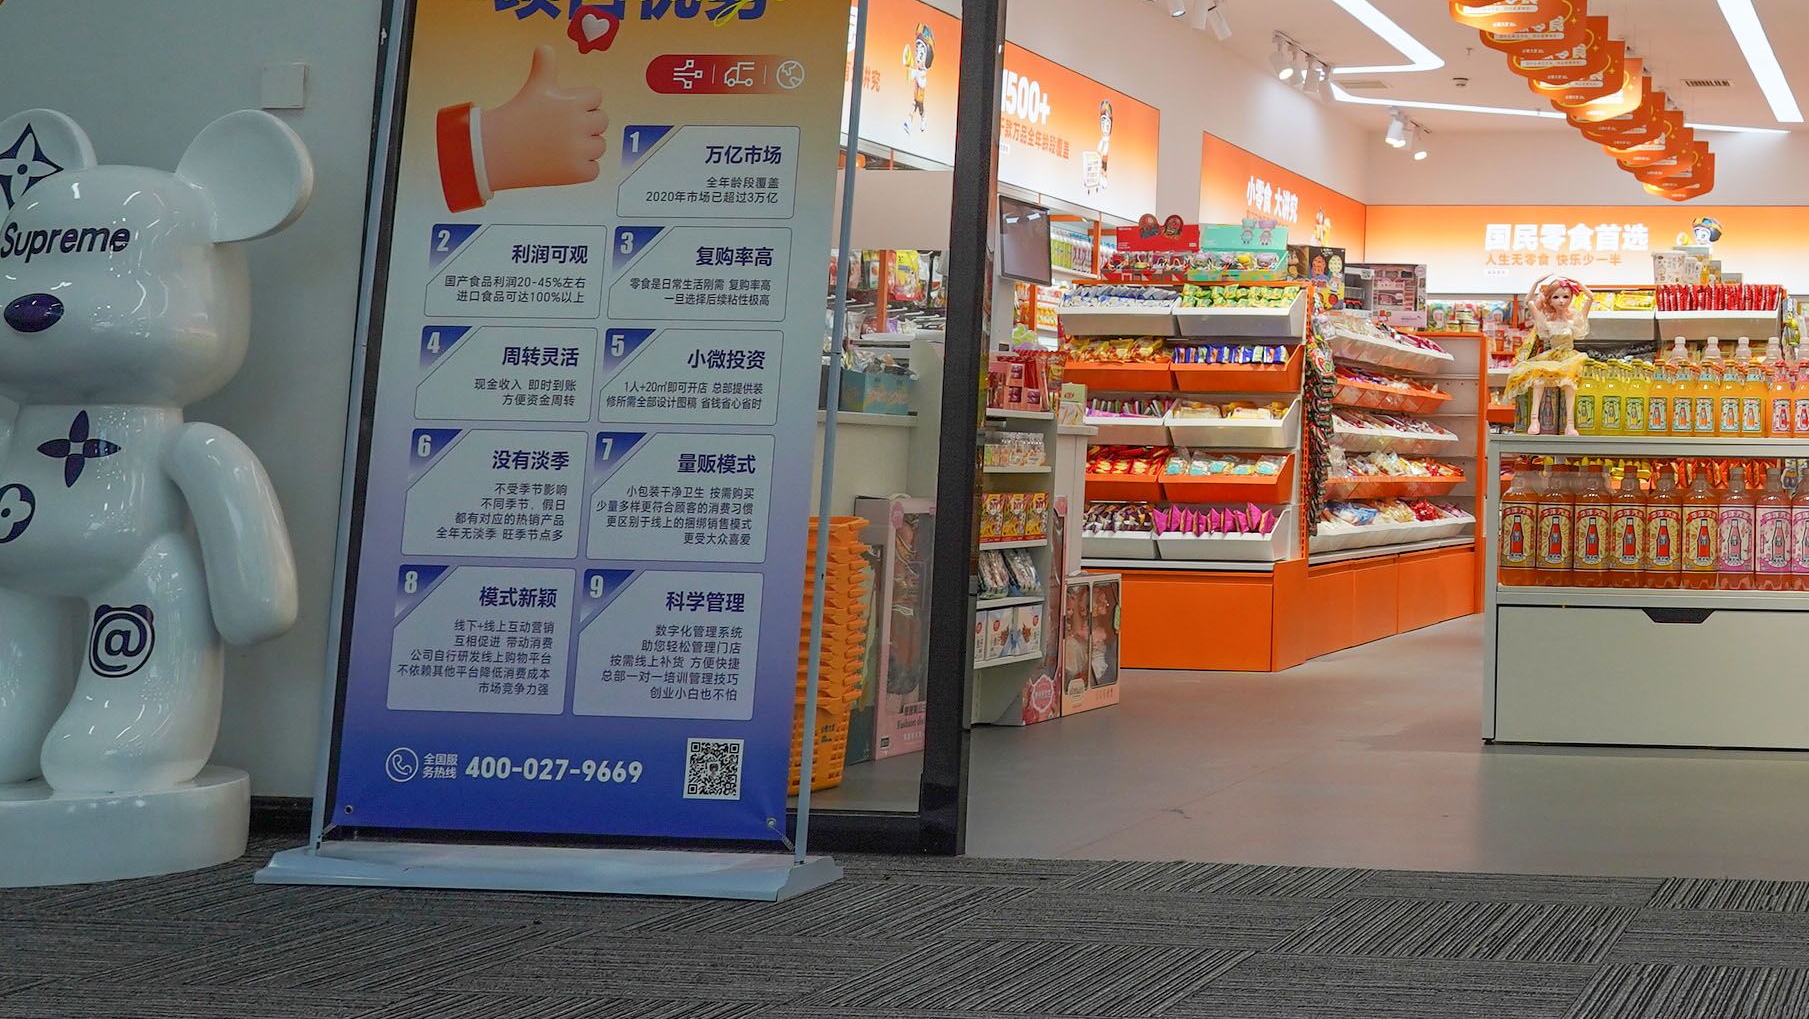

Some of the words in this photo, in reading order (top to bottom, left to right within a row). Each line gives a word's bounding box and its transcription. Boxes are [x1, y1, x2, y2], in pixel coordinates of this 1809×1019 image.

[629, 131, 640, 153] 1
[704, 145, 782, 165] 万亿市场
[705, 176, 780, 190] 全年龄段覆盖
[646, 190, 779, 204] 2020年市场已超过3万亿
[1247, 175, 1272, 214] 小零食
[1274, 188, 1299, 224] 大讲究
[0, 222, 131, 261] Supreme
[437, 231, 449, 251] 2
[621, 233, 633, 254] 3
[1484, 223, 1649, 251] 国民零食首选
[512, 245, 588, 265] 利润可观
[696, 246, 774, 267] 复购率高
[1485, 254, 1550, 266] 人生无零食
[1557, 255, 1622, 266] 快乐少一半
[445, 275, 586, 289] 国产食品利润20-45%左右
[630, 278, 724, 291] 零食是日常生活刚需
[728, 279, 771, 292] 复购率高
[456, 290, 584, 304] 进口食品可达100%以上
[664, 293, 770, 306] 一旦选择后续粘性极高
[427, 332, 441, 353] 4
[611, 335, 625, 357] 5
[502, 346, 579, 367] 周转灵活
[687, 349, 765, 370] 小微投资
[474, 378, 522, 391] 现金收入
[528, 379, 577, 392] 即时到账
[711, 382, 763, 395] 总部提供装
[502, 393, 576, 407] 方便资金周转
[606, 396, 697, 409] 修所需全部设计图稿
[701, 397, 762, 410] 省钱省心省时
[418, 434, 432, 456] 6
[601, 439, 613, 461] 7
[492, 450, 570, 471] 没有淡季
[677, 454, 756, 475] 量贩模式
[495, 483, 568, 496] 不受季节影响
[626, 486, 705, 499] 小包装干净卫生
[710, 487, 755, 500] 按需购买
[597, 500, 754, 515] 少量多样更符合顾客的消费习惯
[455, 512, 565, 527] 都有对应的热销产品
[606, 515, 752, 531] 更区别于线上的捆绑销售模式
[436, 527, 497, 540] 全年无淡季
[502, 528, 563, 542] 旺季节点多
[683, 531, 751, 546] 更受大众喜爱
[405, 571, 418, 594] 8
[590, 575, 604, 598] 9
[479, 587, 557, 608] 模式新颖
[665, 592, 745, 613] 科学管理
[454, 619, 555, 634] 线下+线上互动营销
[655, 624, 743, 639] 数字化管理系统
[454, 634, 501, 648] 互相促进
[506, 636, 553, 649] 带动消费
[641, 640, 741, 654] 助您轻松管理门店
[410, 649, 551, 665] 公司自行研发线上购物平台
[610, 654, 685, 669] 按需线上补货
[690, 656, 740, 670] 方便快捷
[397, 664, 550, 680] 不依赖其他平台降低消费成本
[601, 670, 738, 686] 总部一对一培训管理技巧
[478, 682, 549, 696] 市场竞争力强
[650, 686, 737, 702] 创业小白也不怕
[423, 753, 458, 766] 全国服
[422, 766, 457, 779] 务热线
[465, 756, 643, 783] 400-027-9669
